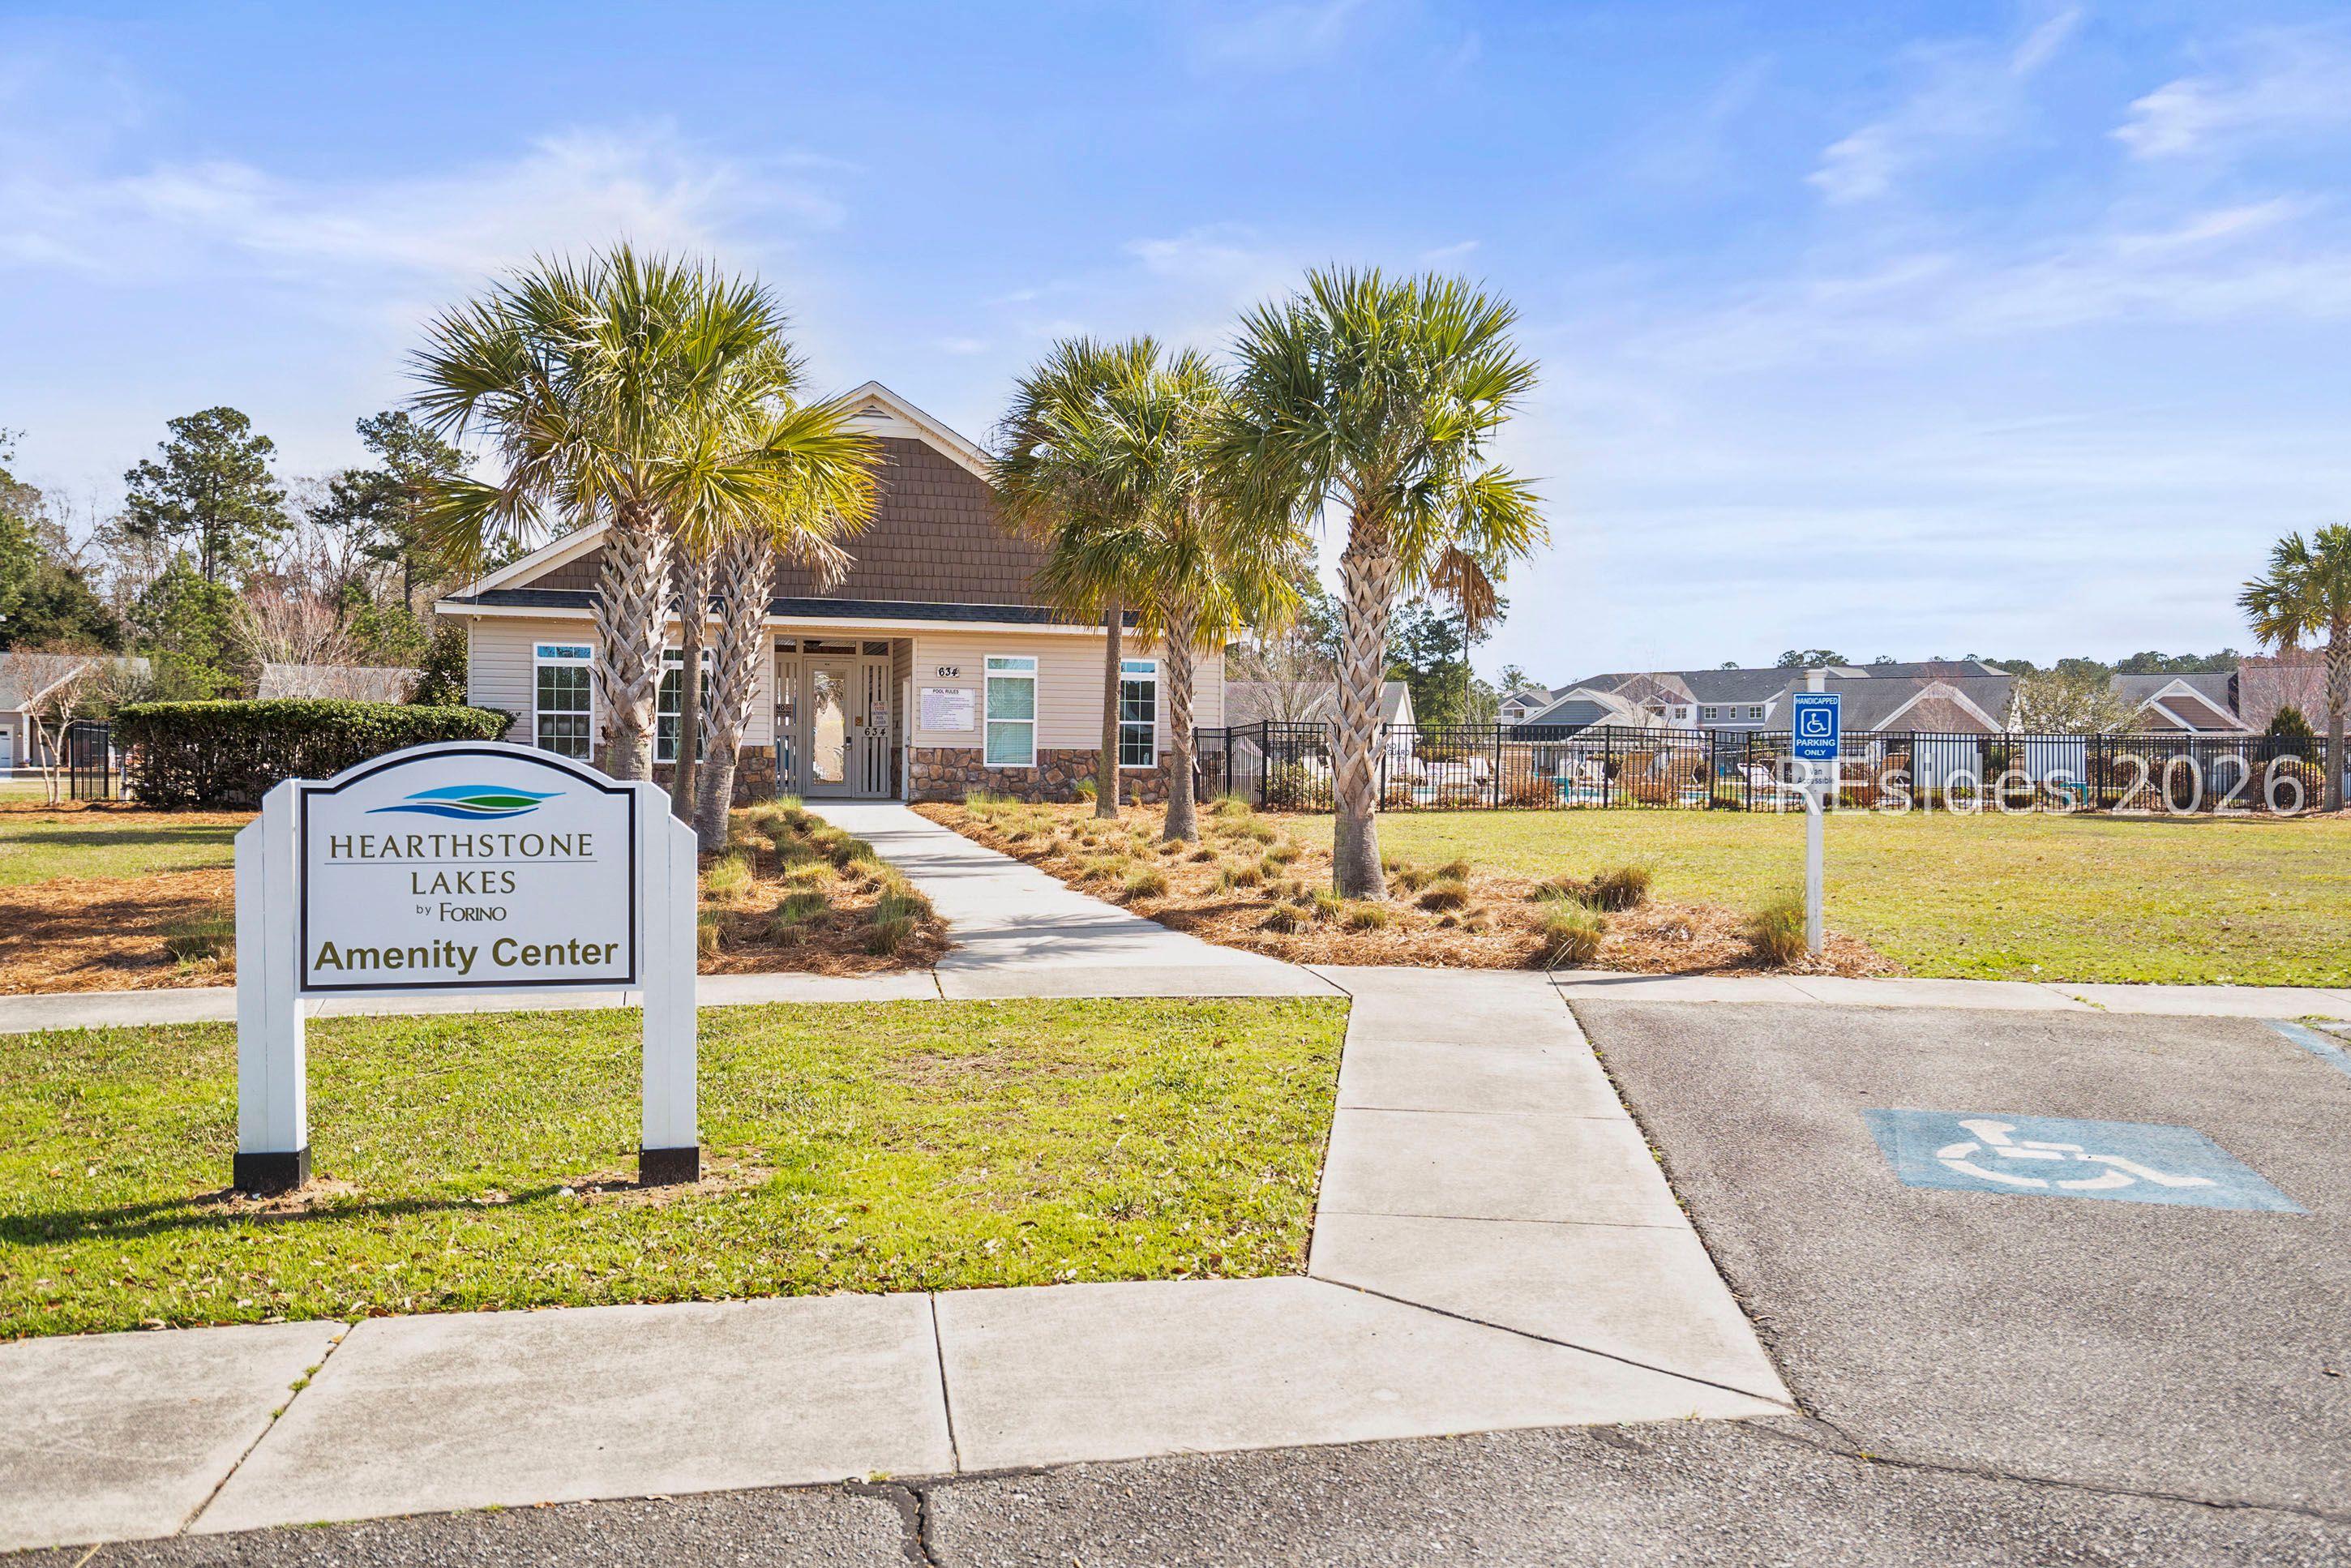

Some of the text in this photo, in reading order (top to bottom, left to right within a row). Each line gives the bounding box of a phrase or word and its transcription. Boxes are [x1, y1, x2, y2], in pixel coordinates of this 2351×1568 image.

[938, 666, 958, 677] 634
[1795, 696, 1839, 705] HANDICAPPED
[864, 727, 886, 736] 634
[1796, 739, 1836, 747] PARKING
[1809, 767, 1823, 775] Van
[1797, 776, 1835, 784] Accessible
[330, 833, 593, 859] HEARTHSTONE
[411, 870, 516, 895] LAKES
[416, 902, 507, 922] by FORINO
[314, 937, 619, 976] Amenity Center
